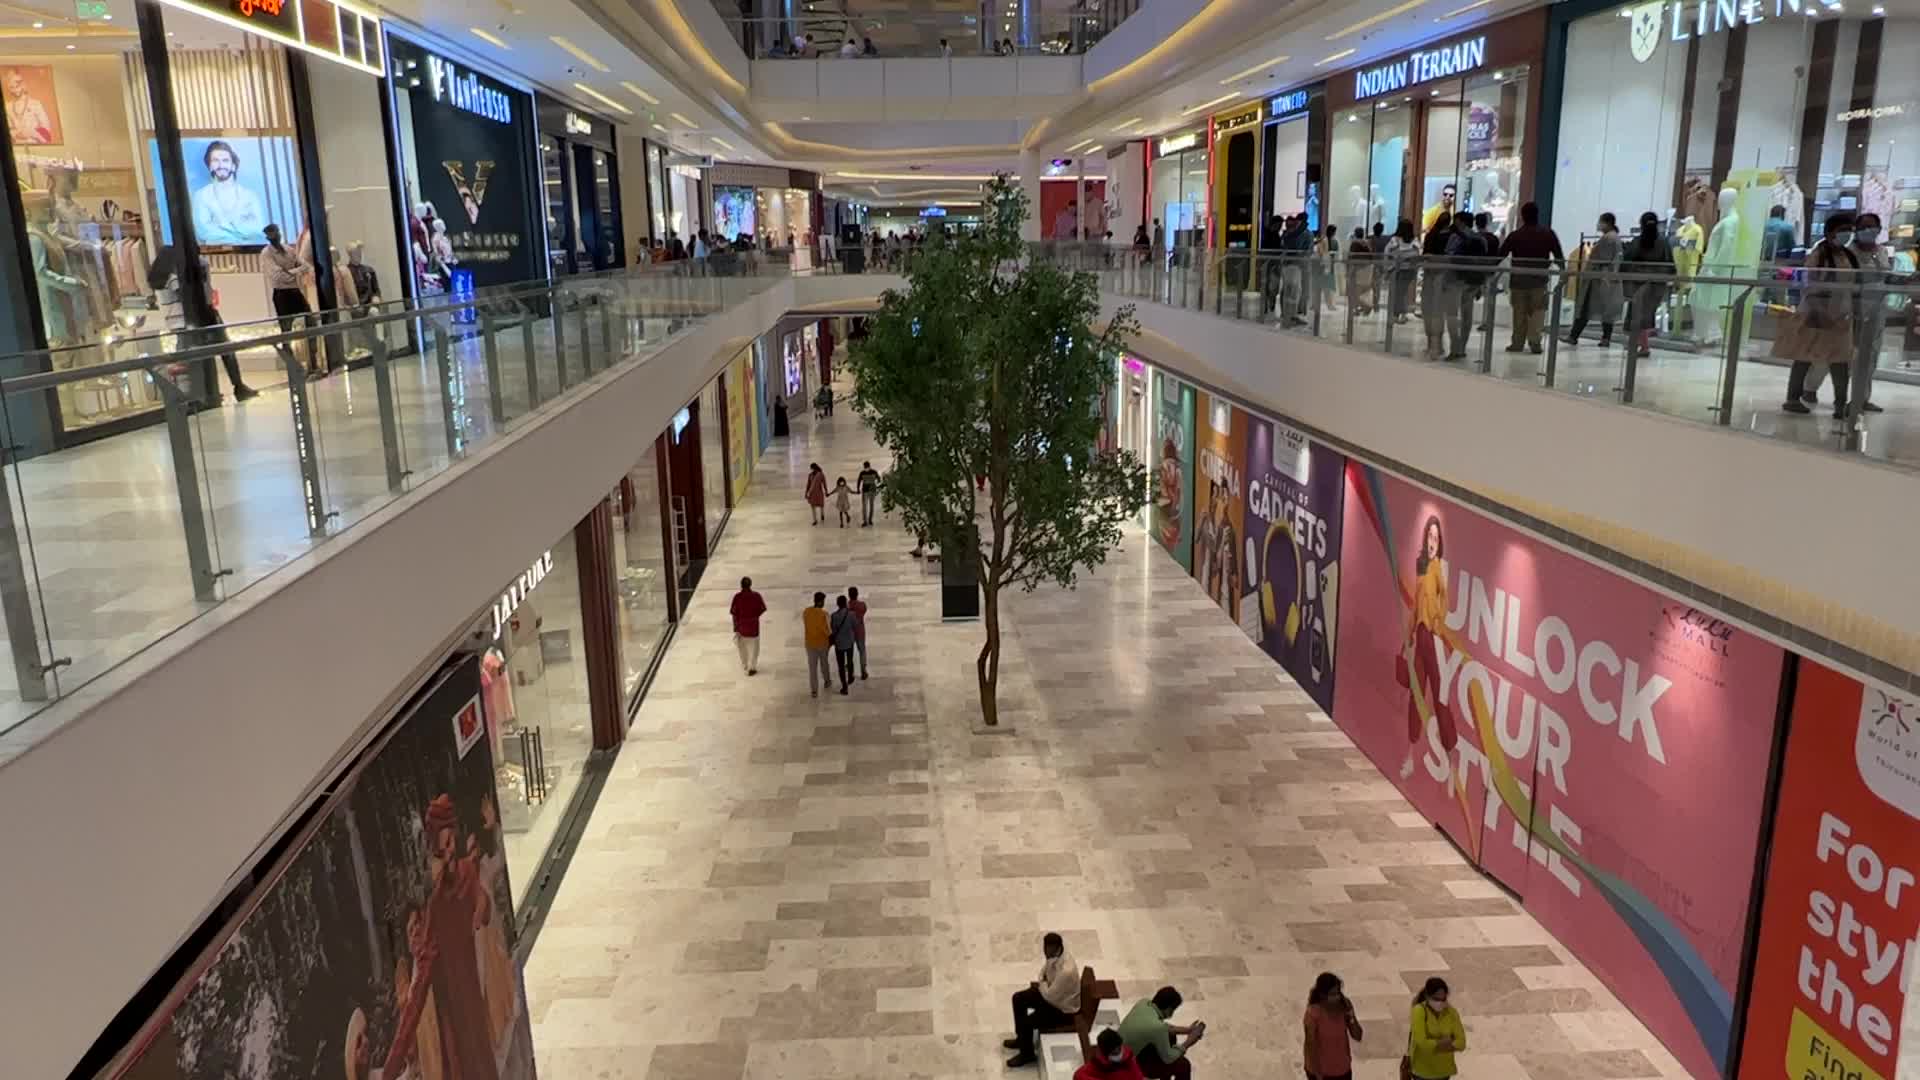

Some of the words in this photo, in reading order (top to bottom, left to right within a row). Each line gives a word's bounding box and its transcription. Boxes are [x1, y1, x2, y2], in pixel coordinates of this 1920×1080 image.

[1355, 61, 1408, 100] INDIAN
[1410, 36, 1486, 84] TERRAIN
[1249, 479, 1328, 559] GADGETS
[1441, 558, 1673, 766] UNLOCK
[1683, 626, 1729, 657] MALL
[1432, 635, 1572, 797] YOUR
[1867, 729, 1901, 752] World
[1423, 715, 1582, 898] STYLE
[1799, 944, 1893, 1057] the
